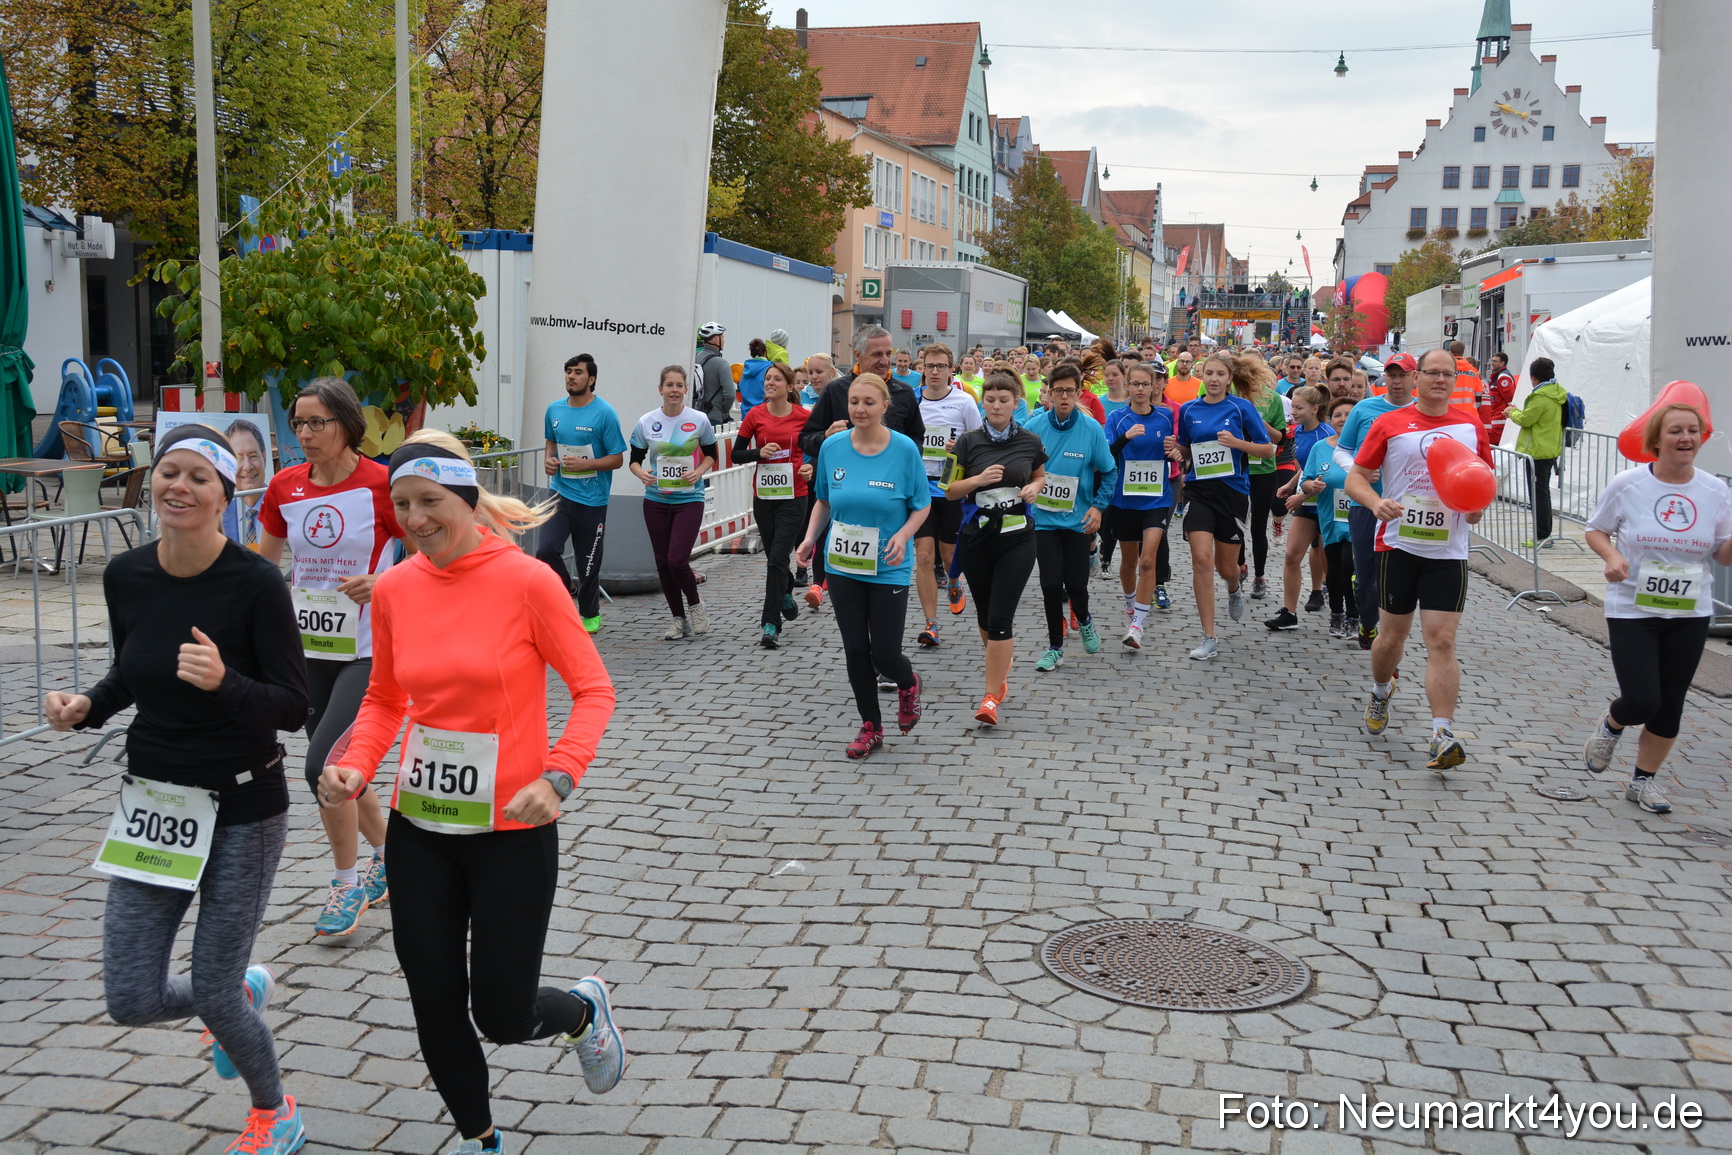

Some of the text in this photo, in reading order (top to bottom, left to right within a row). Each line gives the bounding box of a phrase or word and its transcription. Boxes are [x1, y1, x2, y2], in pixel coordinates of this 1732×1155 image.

[67, 241, 79, 250] Hut
[87, 242, 104, 251] Mode
[864, 281, 879, 296] D
[529, 314, 666, 336] www.bmw-laufsport.de
[1685, 335, 1731, 347] www.
[1224, 418, 1230, 426] 2
[923, 434, 945, 447] 108
[1198, 450, 1226, 465] 5237
[760, 474, 788, 486] 5060
[868, 480, 895, 489] BOCK
[1129, 471, 1158, 483] 5116
[1406, 509, 1445, 526] 5158
[1412, 528, 1435, 537] Andreas
[834, 537, 870, 557] 5147
[1636, 534, 1669, 543] LAUFEN
[1692, 539, 1711, 549] HERZ
[585, 522, 604, 577] Champion
[337, 557, 358, 567] HERZ
[1645, 576, 1692, 596] 5047
[1651, 597, 1680, 607] Rebecca
[297, 609, 347, 633] 5067
[310, 638, 335, 648] Renate
[430, 737, 465, 751] BOCK
[408, 757, 479, 796] 5150
[153, 789, 186, 805] BOCK
[421, 800, 459, 817] Sabrina
[126, 807, 199, 848] 5039
[134, 850, 174, 868] Bettina
